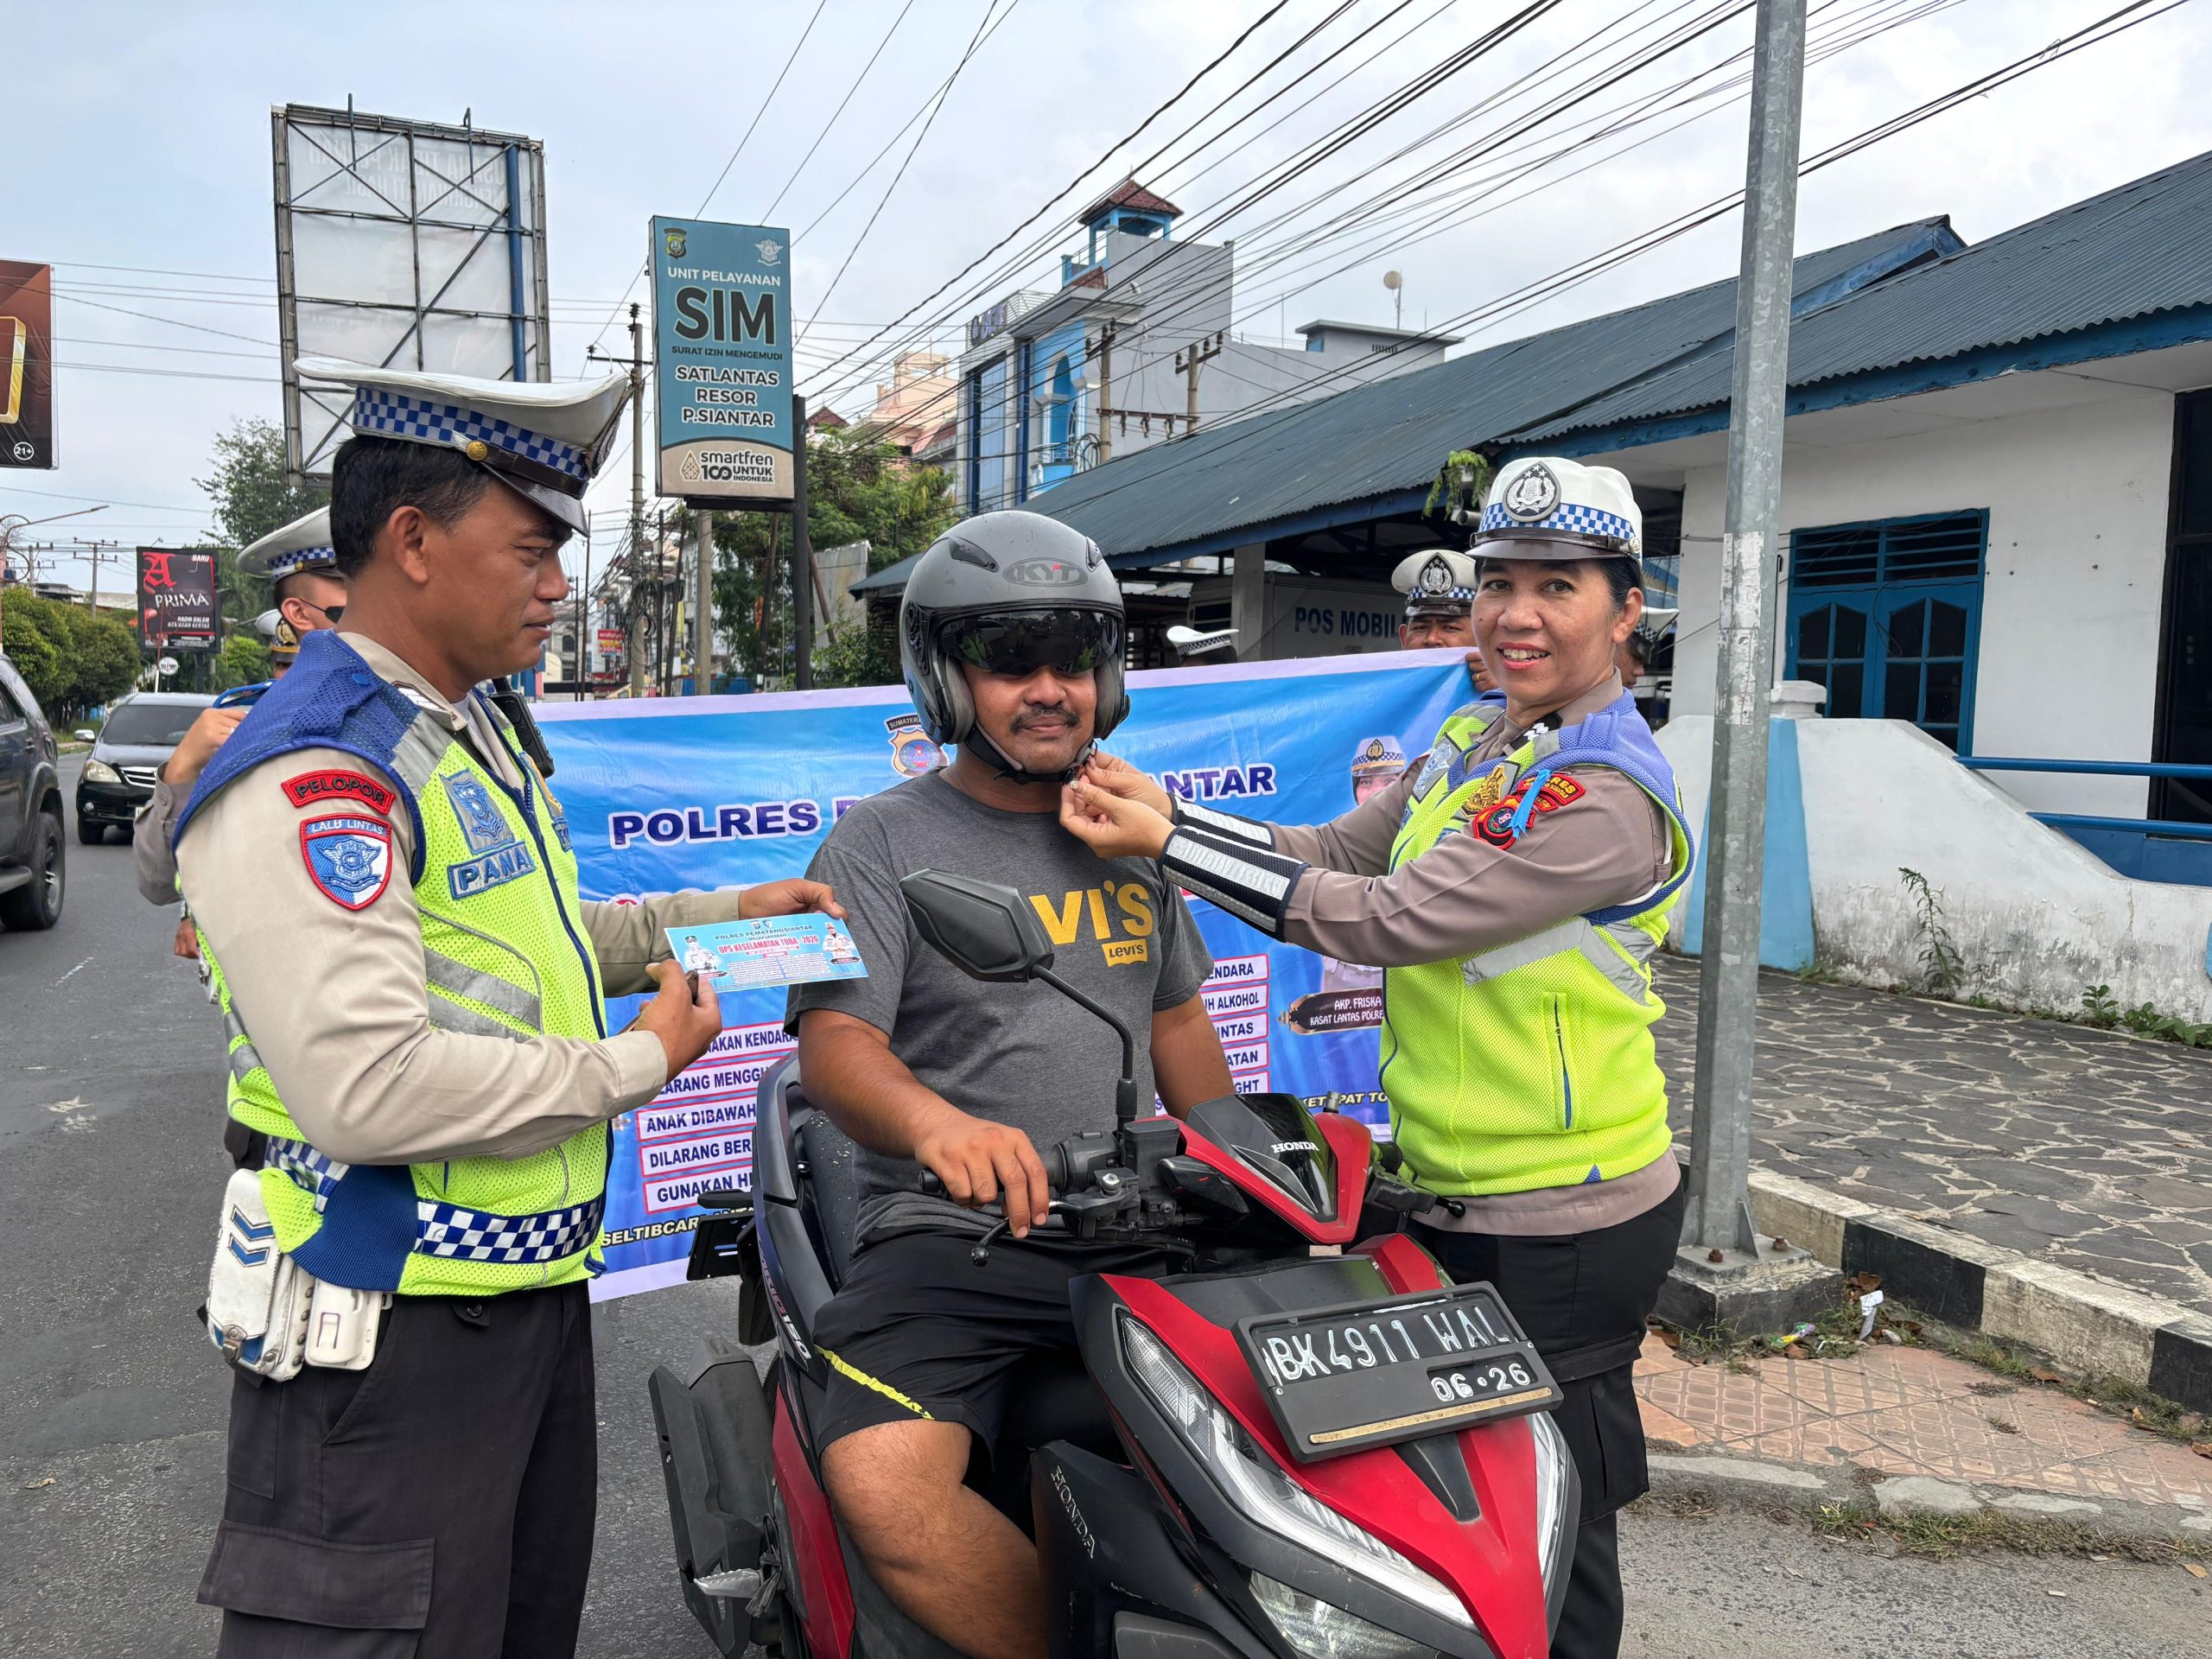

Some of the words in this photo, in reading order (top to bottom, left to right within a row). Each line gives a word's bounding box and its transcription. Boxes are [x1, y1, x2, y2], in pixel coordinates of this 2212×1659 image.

[668, 267, 699, 280] UNIT
[702, 270, 780, 286] PELAYANAN
[675, 287, 775, 345] SIM
[671, 346, 702, 356] SURAT
[724, 350, 783, 361] MENGEMUDI
[677, 366, 779, 385] SATLANTAS
[696, 389, 756, 405] RESOR
[683, 409, 774, 427] P.SIANTAR
[16, 447, 32, 455] 21+
[701, 451, 772, 466] smartfren
[733, 466, 772, 476] UNTUK
[1015, 563, 1076, 581] KYT
[156, 593, 209, 608] PRIMA
[1295, 607, 1334, 634] POS
[295, 778, 385, 804] PELOPOR
[1150, 766, 1274, 799] NTAR
[312, 819, 342, 832] LALU
[347, 820, 384, 835] LINTAS
[612, 802, 819, 846] POLRES
[718, 945, 732, 954] OPS
[734, 939, 779, 951] KESELAMATAN
[781, 938, 798, 946] TOBA
[802, 935, 819, 944] 2026
[1208, 963, 1254, 979] NDARA
[1217, 992, 1259, 1010] ALKOHOL
[1334, 999, 1352, 1010] AKP.
[1353, 996, 1382, 1009] FRISKA
[1310, 1016, 1332, 1026] KASAT
[1333, 1013, 1360, 1023] LANTAS
[647, 1112, 687, 1133] ANAK
[691, 1103, 755, 1126] DIBAWAH
[650, 1143, 719, 1167] DILARANG
[1270, 1141, 1319, 1154] HONDA
[658, 1175, 732, 1203] GUNAKAN
[1423, 1306, 1510, 1351] WAL
[1051, 1465, 1095, 1559] HONDA
